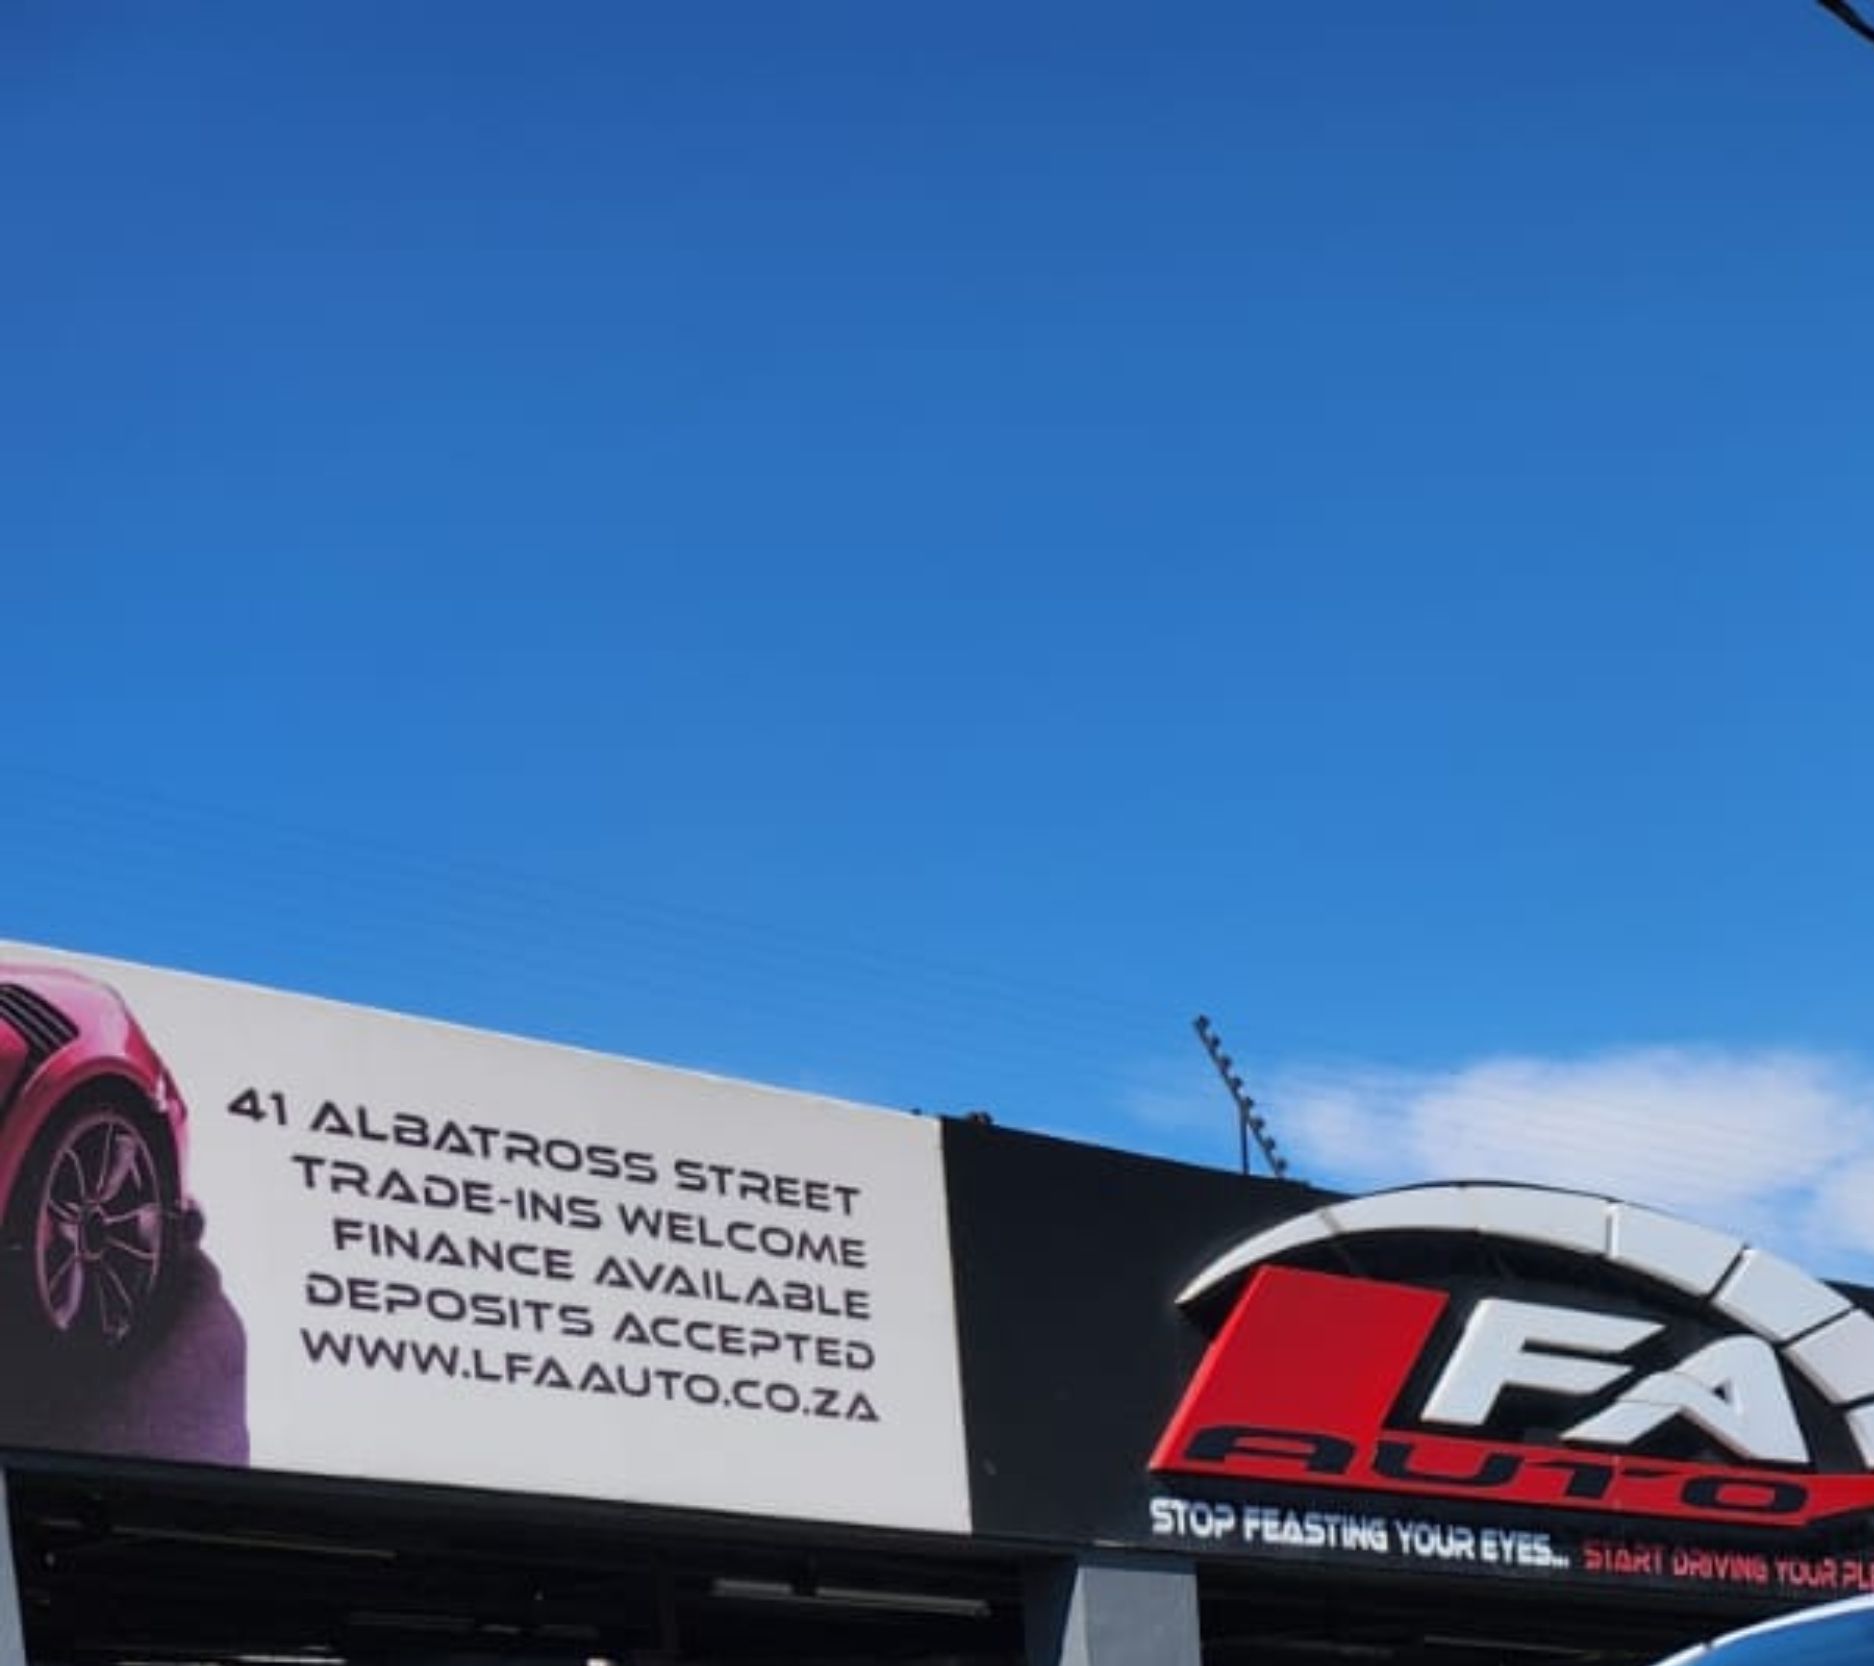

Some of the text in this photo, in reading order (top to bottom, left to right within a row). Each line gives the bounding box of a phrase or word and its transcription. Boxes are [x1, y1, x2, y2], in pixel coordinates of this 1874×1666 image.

[228, 1088, 861, 1217] 41 ALBATROSS STREET
[292, 1155, 868, 1269] TRADE-INS WELCOME
[334, 1217, 872, 1320] FINANCE AVAILABLE
[306, 1273, 876, 1372] DEPOSITS ACCEPTED
[301, 1329, 880, 1423] WWW.LFAAUTO.CO.ZA
[1183, 1424, 1812, 1518] AUTO
[1150, 1496, 1237, 1540] STOP
[1243, 1506, 1388, 1553] FEASTING
[1395, 1518, 1476, 1563] YOUR
[1582, 1541, 1664, 1576] START
[1672, 1548, 1770, 1587] DRIVING
[1775, 1560, 1838, 1589] YOUR
